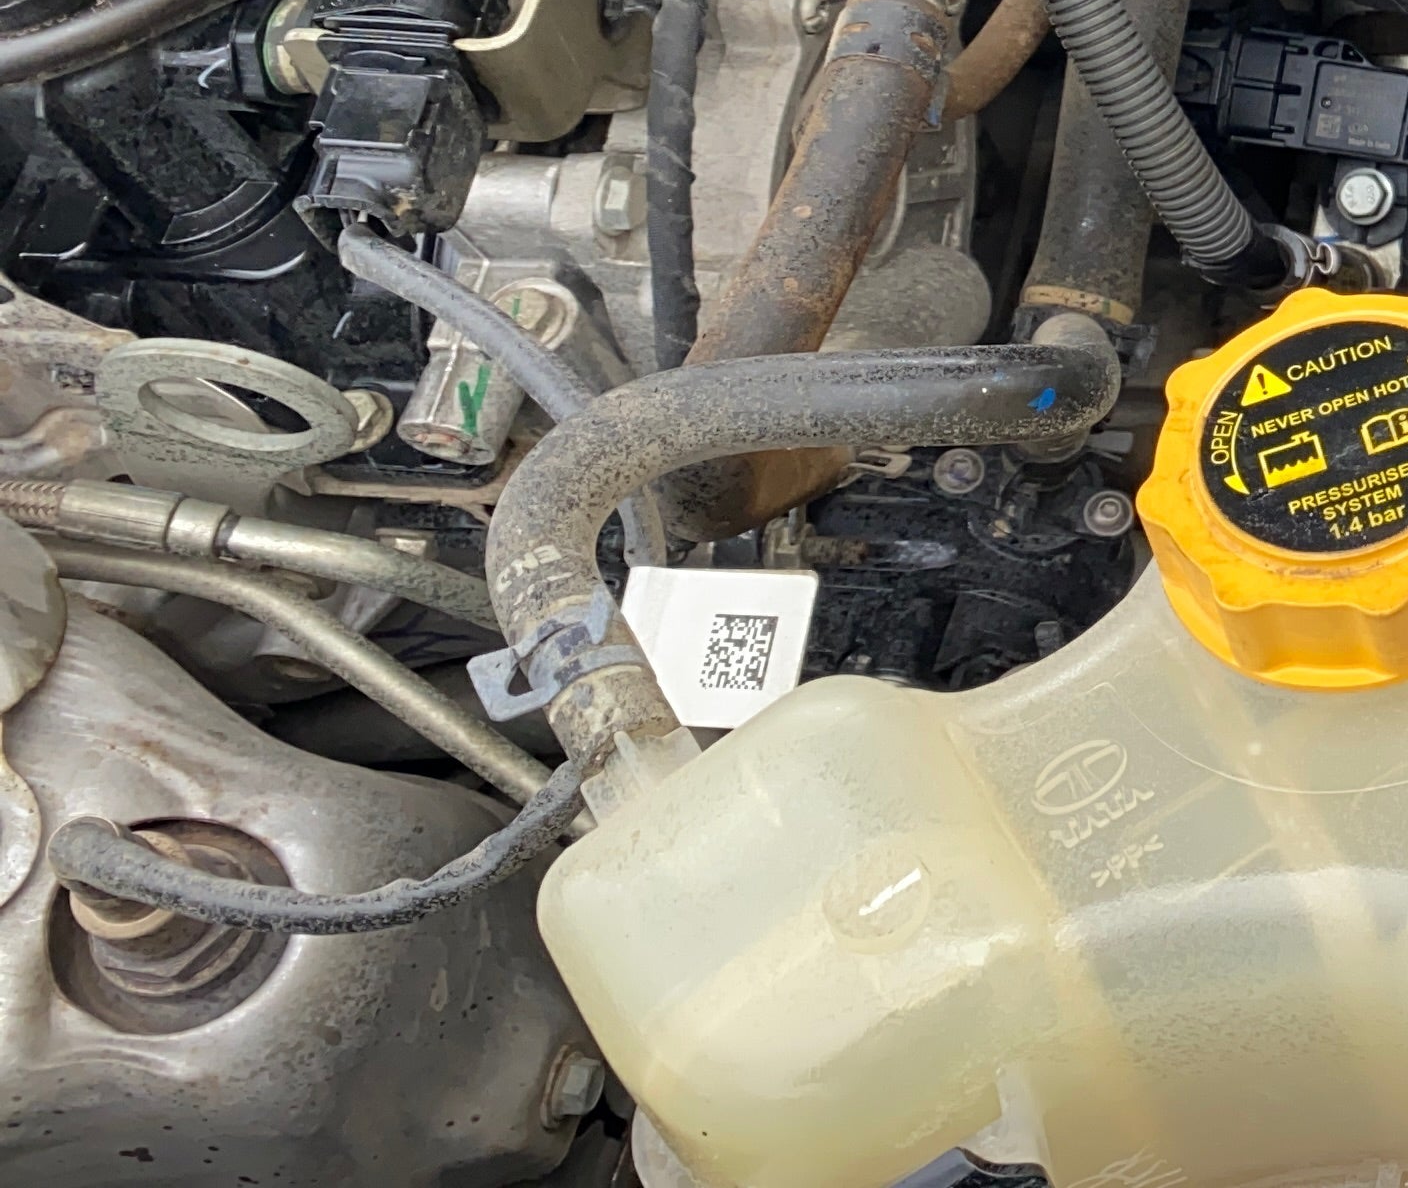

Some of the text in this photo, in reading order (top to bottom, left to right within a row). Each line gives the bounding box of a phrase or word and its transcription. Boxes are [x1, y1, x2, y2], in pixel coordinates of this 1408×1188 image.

[1286, 335, 1392, 382] CAUTION
[1210, 411, 1239, 465] OPEN
[1251, 408, 1315, 439] NEVER
[1318, 389, 1371, 418] OPEN
[1322, 484, 1403, 521] SYSTEM
[1329, 503, 1407, 541] 1.4 bar
[1050, 783, 1155, 849] TATA
